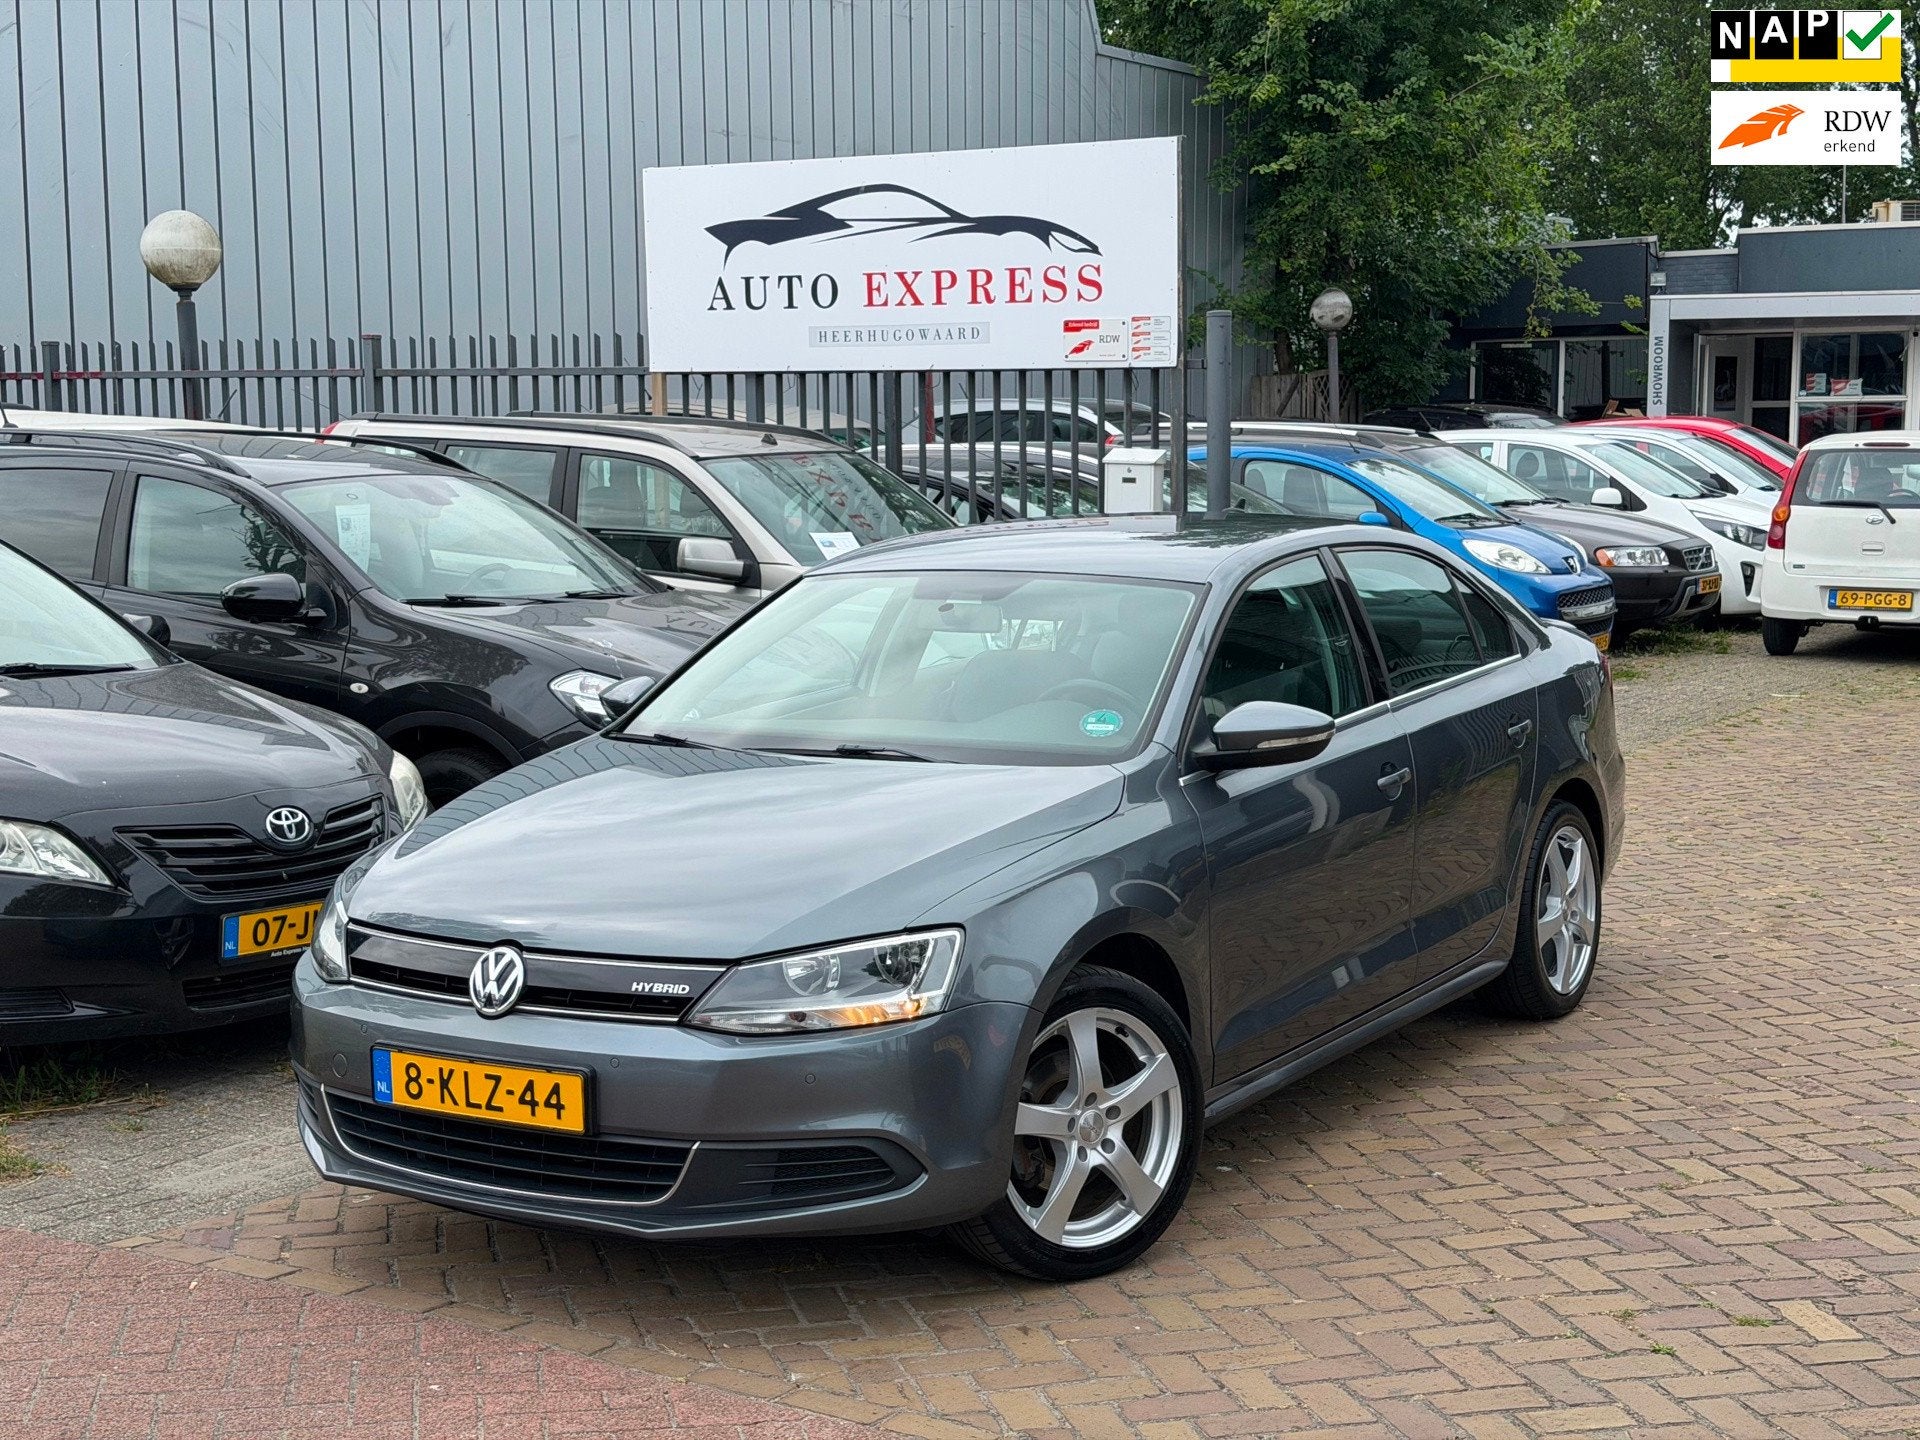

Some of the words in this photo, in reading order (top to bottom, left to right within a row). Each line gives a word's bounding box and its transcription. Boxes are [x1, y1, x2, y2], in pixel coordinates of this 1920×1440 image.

[707, 273, 839, 311] AUTO
[862, 263, 1103, 308] EXPRESS
[818, 326, 981, 344] HEERHUGOWAARD
[1099, 334, 1121, 344] RDW
[1652, 335, 1664, 406] SHOWROOM
[1840, 592, 1907, 606] 69-PGG-8
[224, 940, 237, 951] NL
[631, 981, 690, 995] HYBRID
[376, 1080, 391, 1095] NL
[404, 1061, 566, 1120] 8-KLZ-44
